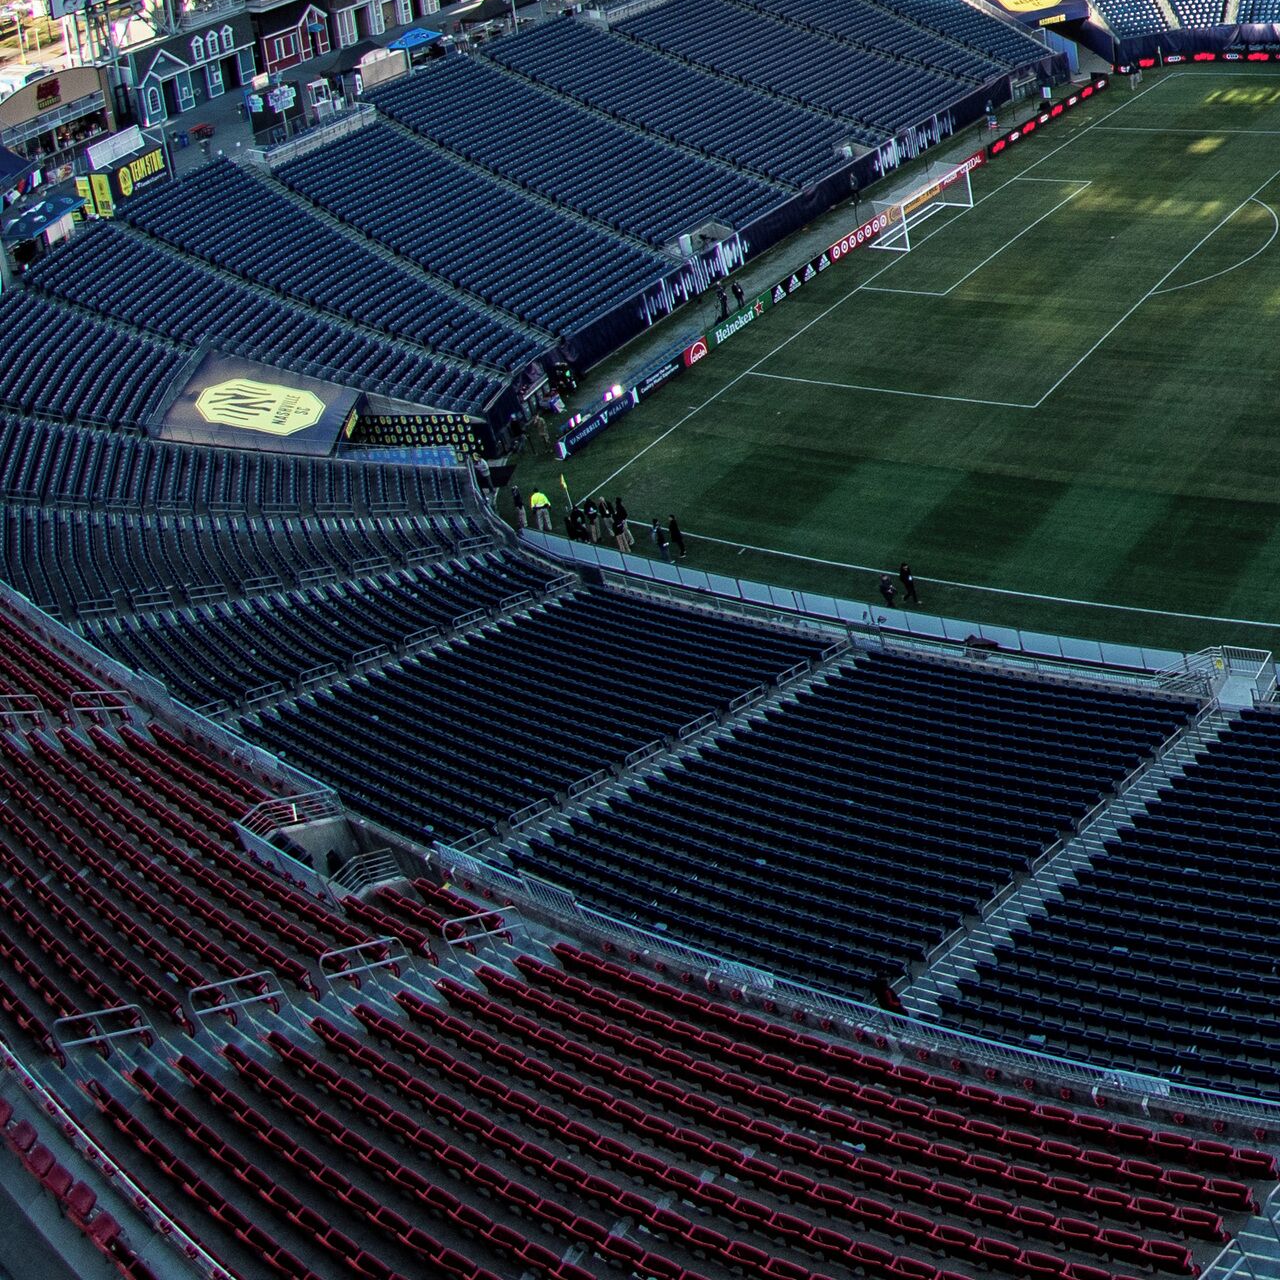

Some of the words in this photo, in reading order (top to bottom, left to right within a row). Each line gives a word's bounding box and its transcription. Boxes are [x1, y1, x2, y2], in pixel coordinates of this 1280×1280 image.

[715, 307, 754, 345] Heineken
[271, 394, 301, 426] NASHVILLE
[569, 420, 601, 446] VANDERBILT
[608, 399, 629, 417] HEALTH
